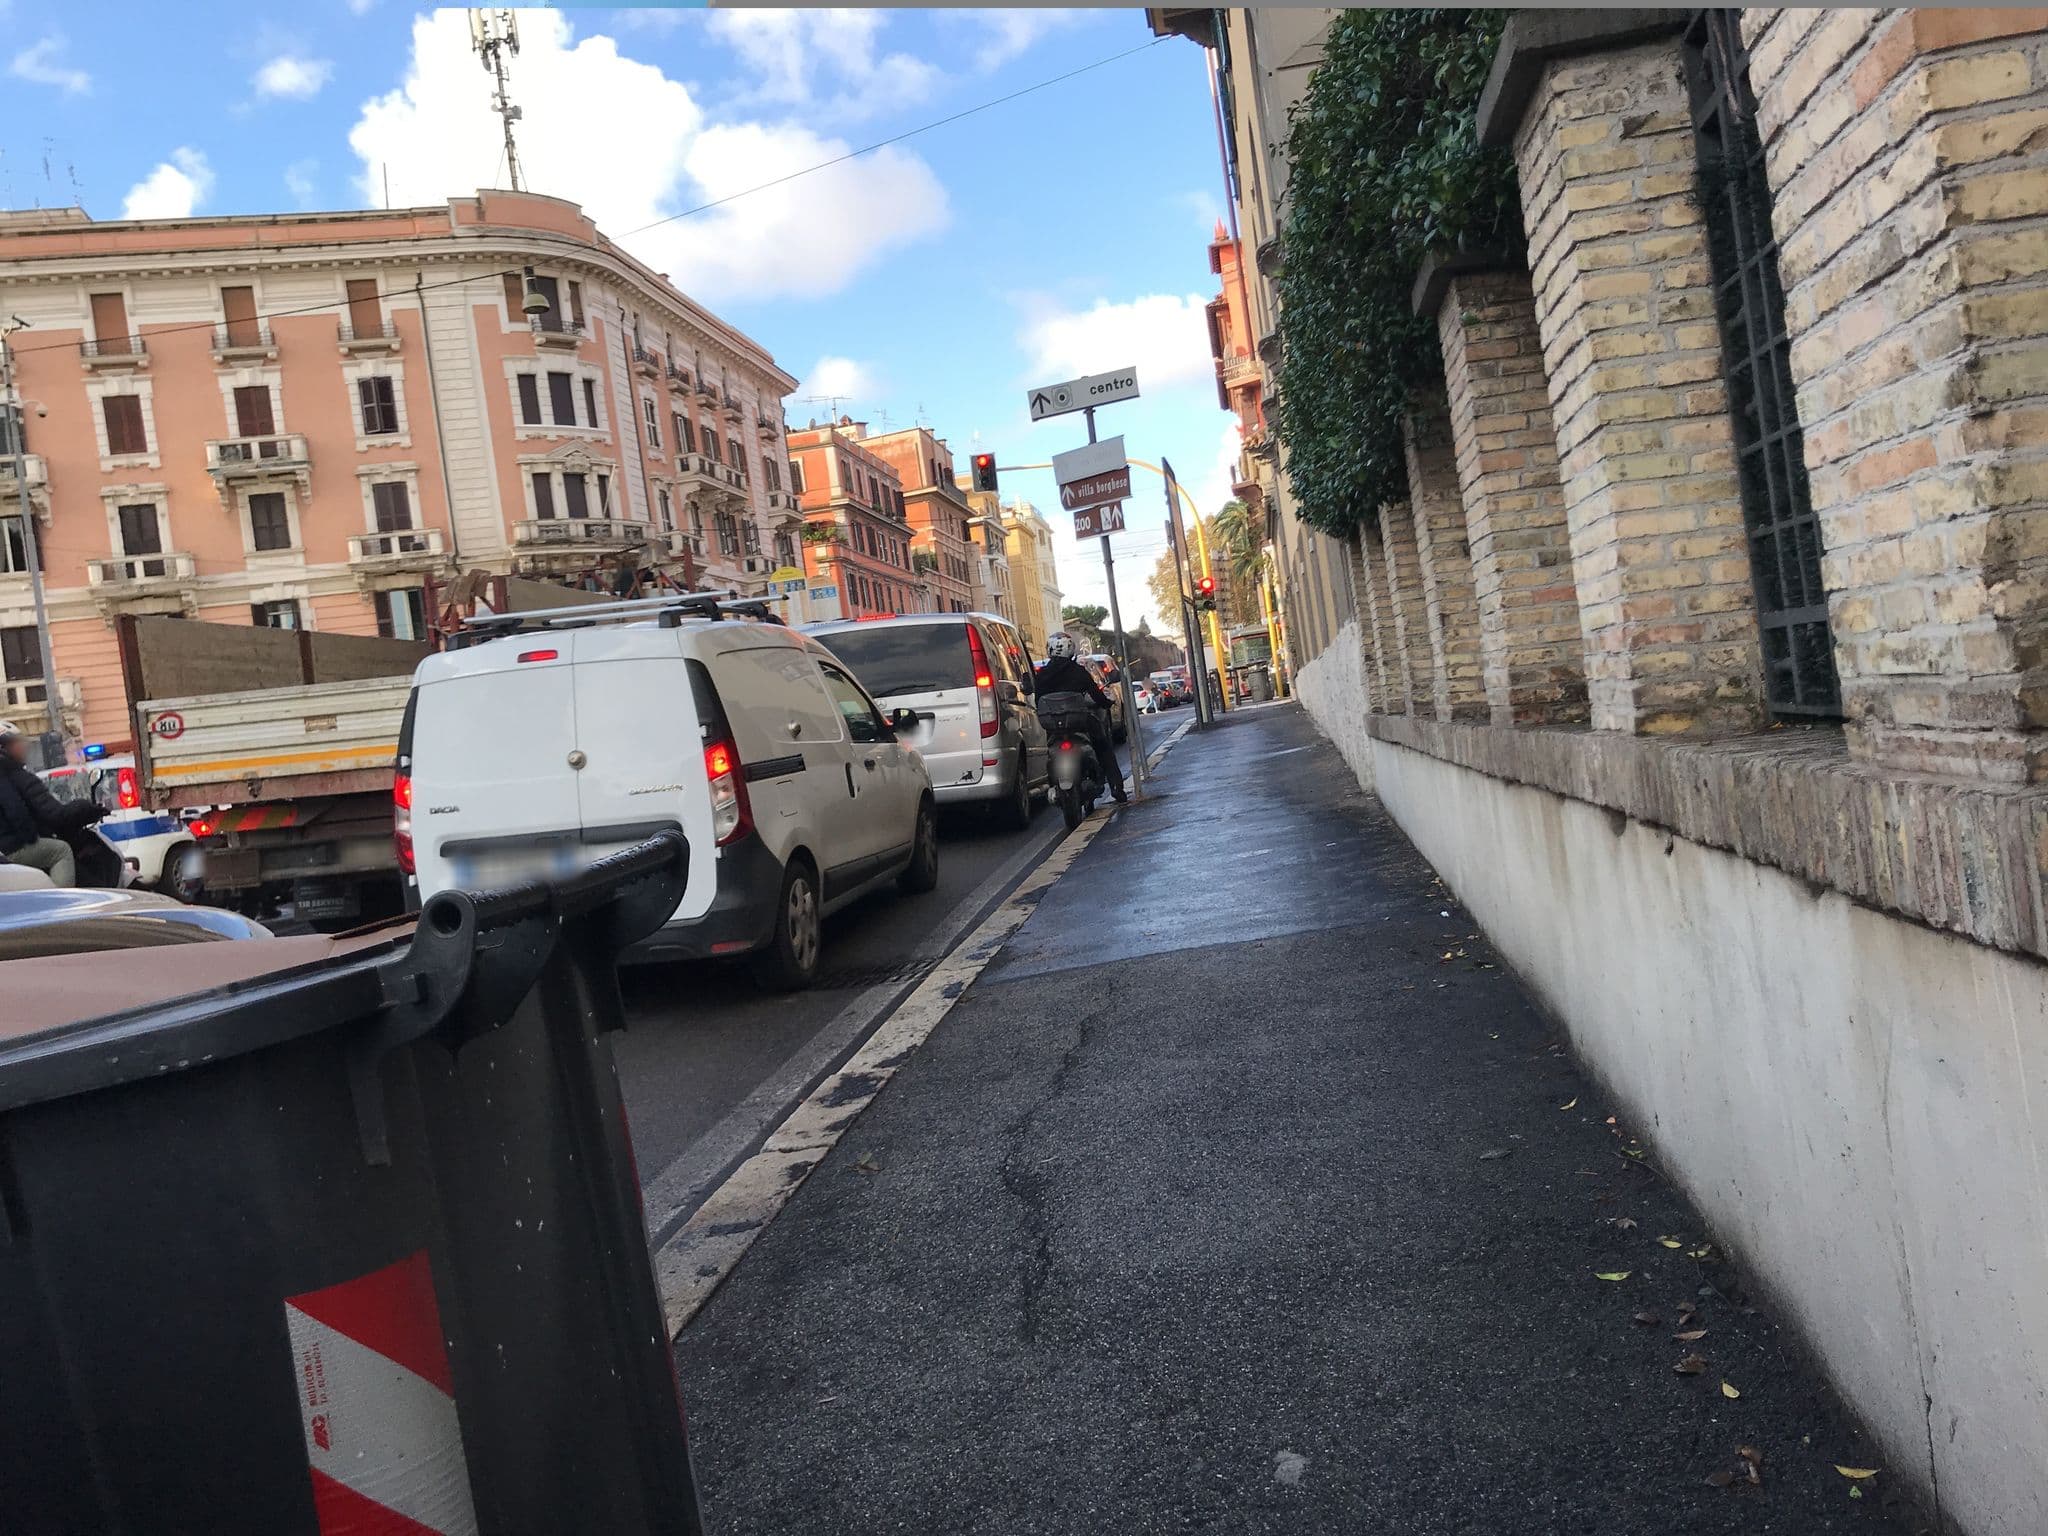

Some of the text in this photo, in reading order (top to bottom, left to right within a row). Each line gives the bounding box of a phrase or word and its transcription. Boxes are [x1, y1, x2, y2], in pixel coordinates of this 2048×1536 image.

[1090, 377, 1133, 395] centro
[1078, 478, 1127, 498] villa borghese
